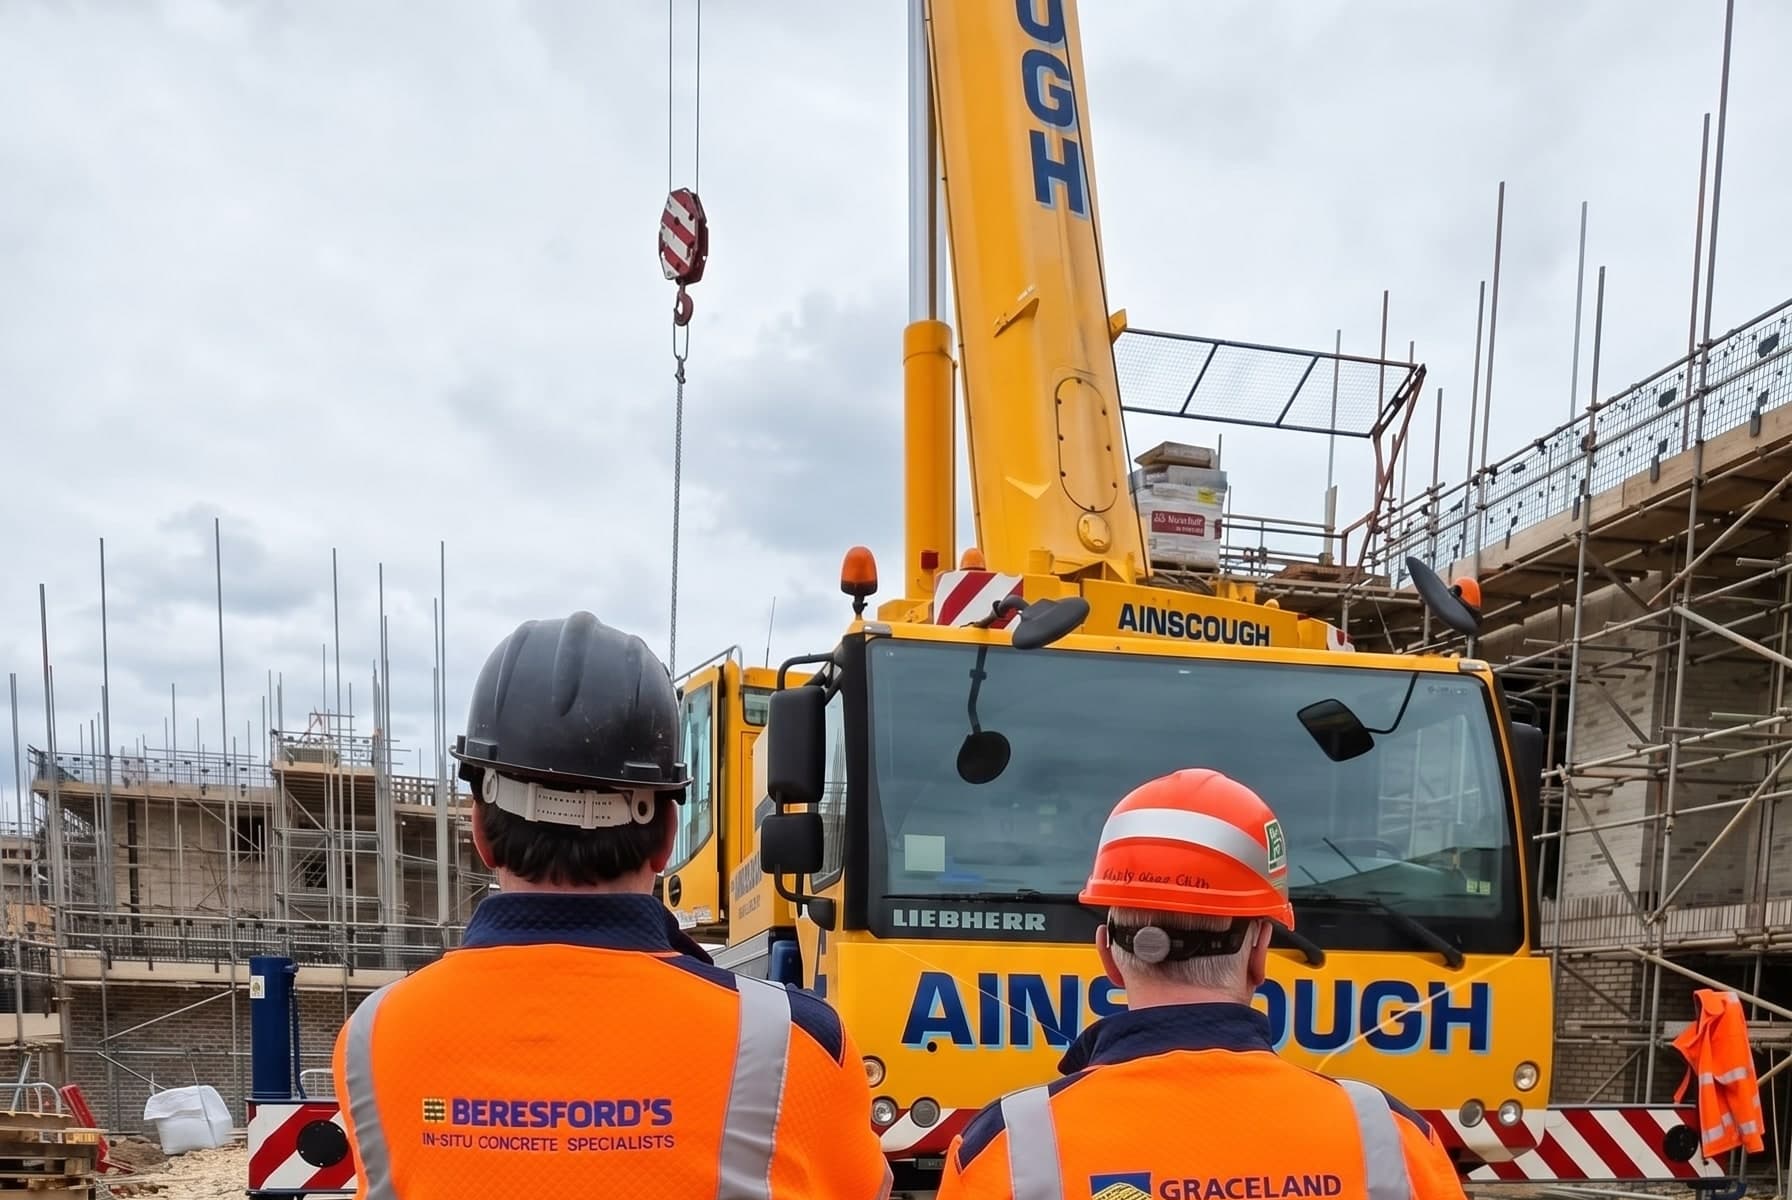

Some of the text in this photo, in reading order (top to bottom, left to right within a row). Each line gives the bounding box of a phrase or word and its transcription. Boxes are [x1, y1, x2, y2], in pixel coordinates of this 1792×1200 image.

[1118, 603, 1270, 646] AINSCOUGH
[893, 909, 1046, 931] LIEBHERR
[901, 971, 1489, 1051] AINUGH
[452, 1099, 673, 1127] BERESFORD'S
[422, 1132, 675, 1151] IN-SITU CONCRETE SPECIALISTS
[1160, 1174, 1342, 1200] GRACELAND
